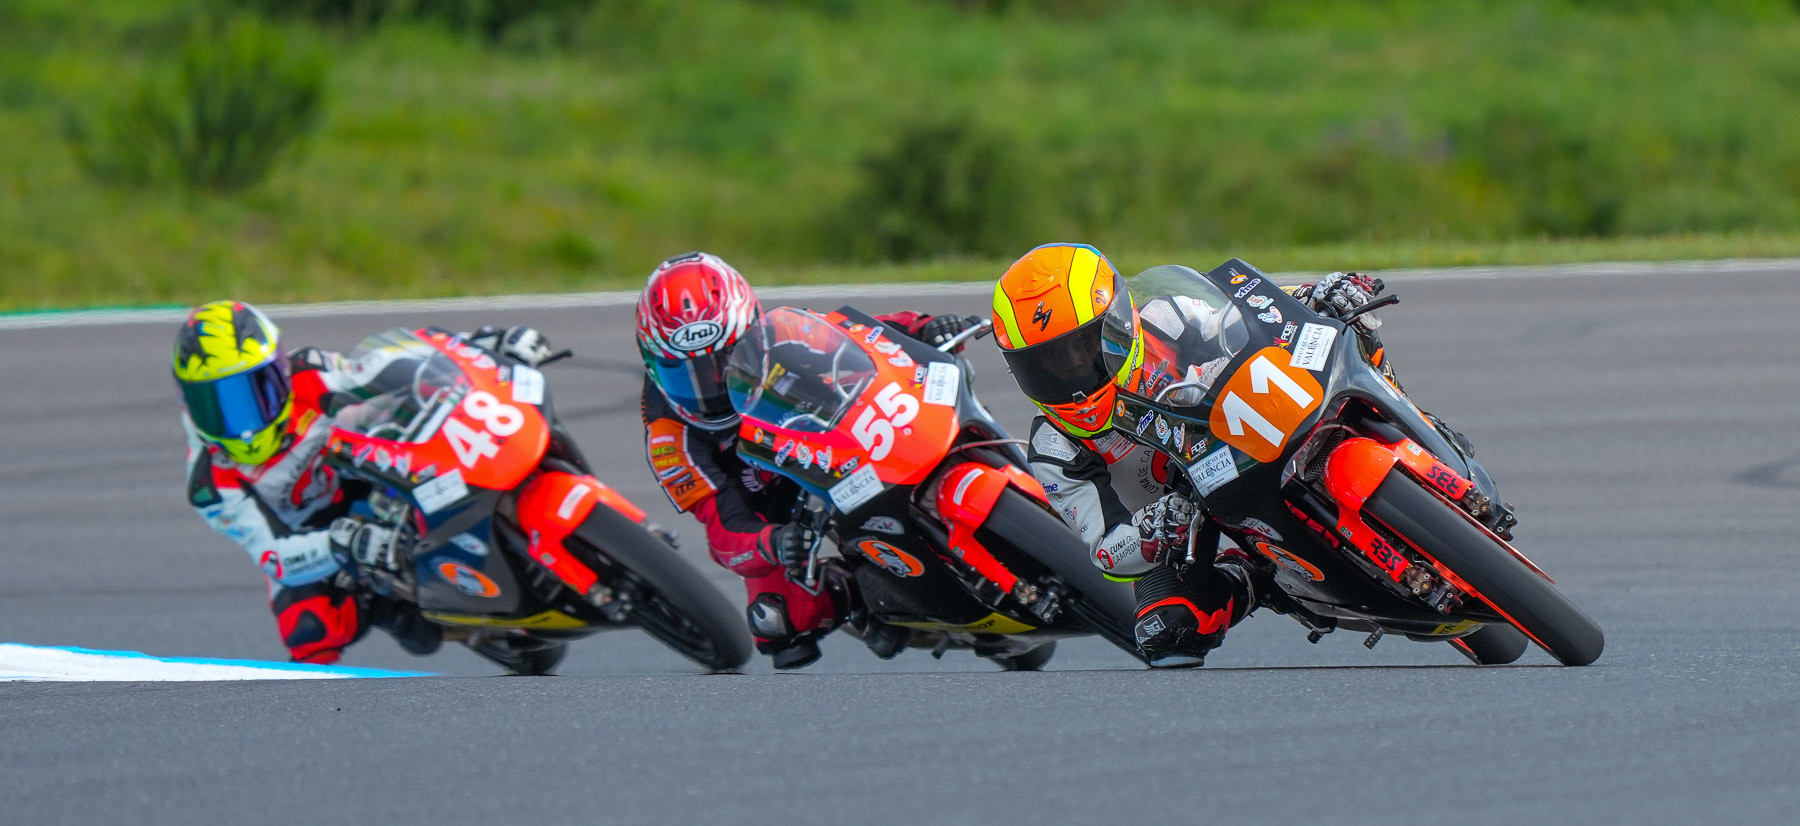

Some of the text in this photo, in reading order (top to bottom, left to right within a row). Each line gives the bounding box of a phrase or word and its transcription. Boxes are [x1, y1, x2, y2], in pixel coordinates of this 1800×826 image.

[677, 324, 714, 346] Arai
[1222, 355, 1314, 447] 11
[441, 391, 524, 469] 48
[851, 382, 919, 461] 55
[1219, 451, 1228, 460] DE
[1138, 466, 1148, 477] DE
[1193, 458, 1232, 484] VALÈNCIA
[1140, 476, 1159, 494] CUNA
[1110, 539, 1127, 554] CUNA
